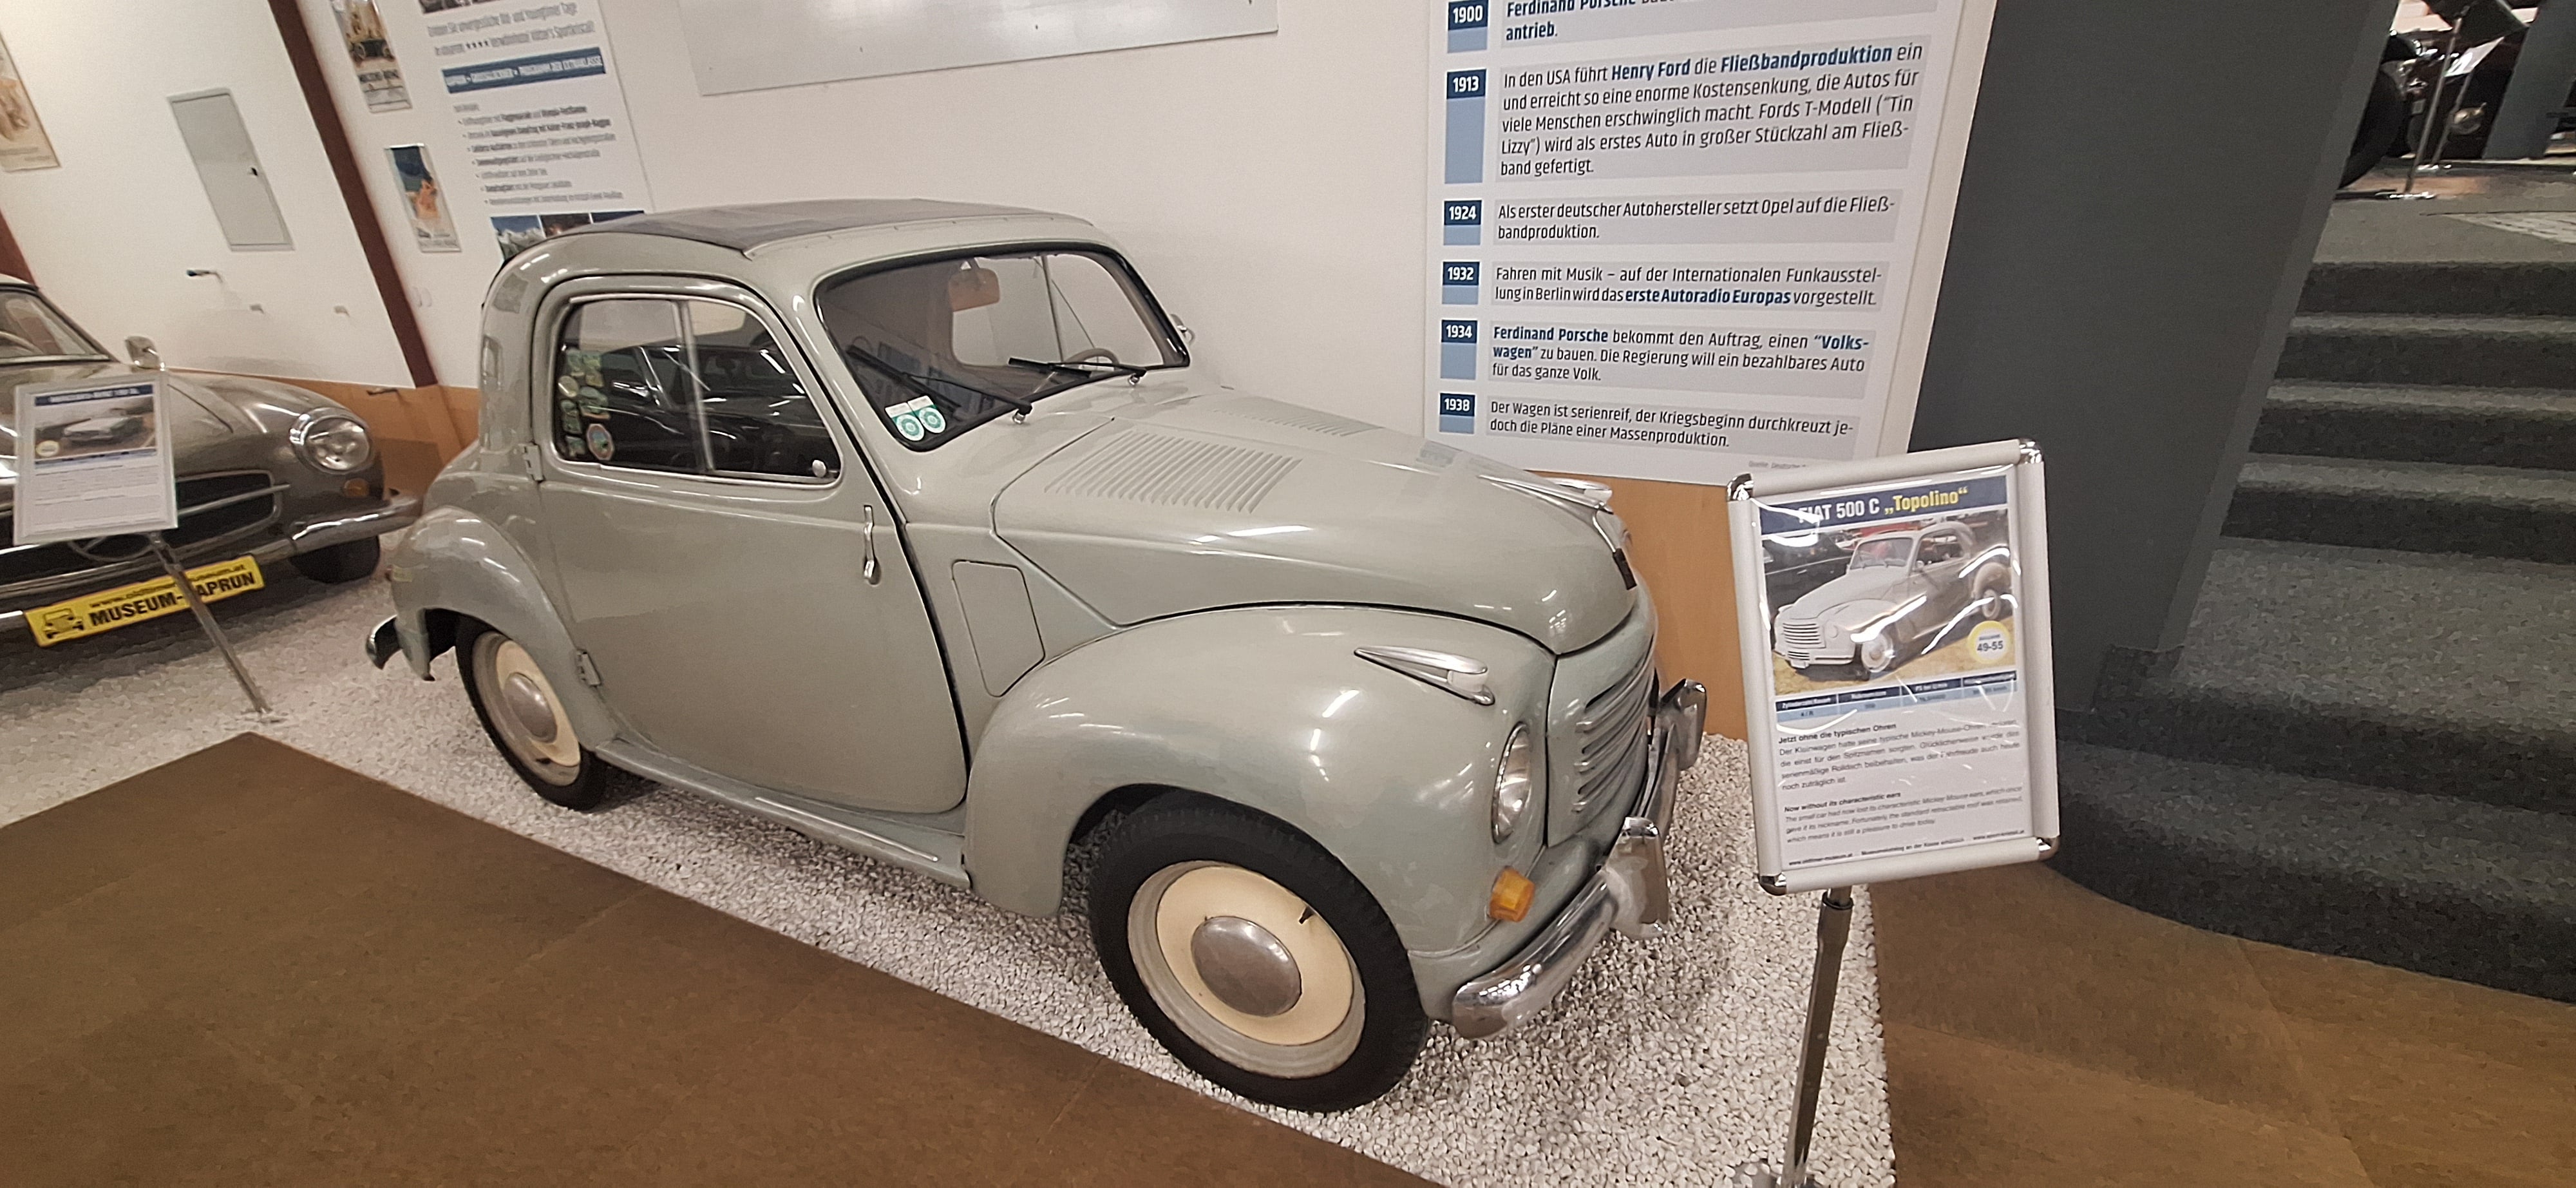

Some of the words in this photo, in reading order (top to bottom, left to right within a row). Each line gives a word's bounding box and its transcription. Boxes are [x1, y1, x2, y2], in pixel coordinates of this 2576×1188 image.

[1453, 5, 1482, 24] 1900
[1507, 0, 1575, 17] Ferdinand
[1506, 22, 1558, 41] antrieb.
[1504, 73, 1515, 88] In
[1519, 72, 1542, 87] den
[1547, 69, 1571, 85] USA
[1575, 66, 1608, 83] führt
[1611, 64, 1654, 81] Henry
[1658, 58, 1691, 77] Ford
[1694, 57, 1717, 75] die
[1721, 45, 1892, 73] Fließbandproduktion
[1897, 42, 1922, 61] ein
[1453, 75, 1479, 93] 1913
[1504, 94, 1527, 111] und
[1530, 91, 1581, 109] erreicht
[1584, 92, 1599, 106] so
[1603, 88, 1631, 104] eine
[1636, 86, 1689, 102] enorme
[1693, 77, 1812, 99] Kostensenkung,
[1817, 73, 1841, 91] die
[1843, 73, 1890, 90] Autos
[1895, 69, 1919, 86] für
[1502, 117, 1531, 133] viele
[1536, 113, 1601, 131] Menschen
[1605, 106, 1700, 127] erschwinglich
[1705, 104, 1754, 122] macht.
[1759, 101, 1800, 119] Fords
[1805, 97, 1871, 117] T-Modell
[1545, 136, 1573, 152] wird
[1577, 135, 1595, 151] als
[1600, 135, 1641, 149] erstes
[1645, 133, 1678, 148] Auto
[1682, 130, 1695, 146] in
[1699, 128, 1751, 148] großer
[1754, 124, 1828, 143] Stückzahl
[1832, 126, 1857, 139] am
[1862, 120, 1909, 139] Fließ-
[1501, 160, 1531, 176] band
[1534, 158, 1594, 177] gefertigt.
[1449, 206, 1477, 221] 1924
[1498, 204, 1516, 219] Als
[1519, 205, 1556, 218] erster
[1557, 202, 1622, 218] deutscher
[1623, 200, 1722, 216] Autohersteller
[1723, 200, 1759, 215] setzt
[1761, 198, 1794, 216] Opel
[1796, 196, 1823, 213] auf
[1824, 196, 1847, 213] die
[1850, 196, 1895, 212] Fließ-
[1498, 224, 1600, 241] bandproduktion.
[1447, 267, 1474, 281] 1932
[1496, 267, 1537, 280] Fahren
[1541, 267, 1562, 281] mit
[1566, 267, 1603, 281] Musik
[1620, 267, 1642, 281] auf
[1646, 267, 1669, 282] der
[1672, 267, 1781, 282] Internationalen
[1786, 267, 1882, 283] Funkausstel-
[1495, 285, 1521, 303] lung
[1522, 285, 1534, 302] in
[1536, 286, 1571, 302] Berlin
[1573, 287, 1600, 302] wird
[1602, 287, 1624, 302] das
[1625, 288, 1660, 303] erste
[1661, 287, 1730, 303] Autoradio
[1732, 289, 1791, 307] Europas
[1794, 289, 1877, 308] vorgestellt.
[1446, 325, 1473, 338] 1934
[1493, 326, 1554, 340] Ferdinand
[1558, 329, 1608, 342] Porsche
[1613, 329, 1674, 345] bekommt
[1679, 331, 1703, 345] den
[1709, 332, 1763, 350] Auftrag,
[1768, 333, 1808, 349] einen
[1540, 349, 1553, 359] zu
[1557, 347, 1597, 361] bauen.
[1600, 349, 1620, 362] Die
[1622, 350, 1689, 367] Regierung
[1692, 352, 1715, 366] will
[1718, 352, 1739, 367] ein
[1743, 354, 1828, 370] bezahlbares
[1830, 358, 1864, 372] Auto
[1493, 363, 1509, 376] für
[1512, 364, 1531, 378] das
[1534, 367, 1569, 380] ganze
[1573, 367, 1601, 381] Volk.
[1444, 398, 1470, 412] 1938
[1491, 401, 1510, 414] Der
[1513, 403, 1550, 417] Wagen
[1554, 404, 1568, 417] ist
[1571, 406, 1632, 423] serienreif,
[1636, 409, 1656, 423] der
[1660, 411, 1745, 429] Kriegsbeginn
[1748, 416, 1832, 434] durchkreuzt
[1833, 420, 1853, 437] je-
[1490, 418, 1517, 432] doch
[1520, 421, 1538, 434] die
[1540, 422, 1573, 436] Pläne
[1577, 424, 1607, 438] einer
[1610, 427, 1729, 447] Massenproduktion.
[1798, 504, 1832, 523] FIAT
[1836, 500, 1865, 519] 500
[1869, 498, 1880, 514] C
[89, 572, 255, 627] MUSEUM-APRUN
[1977, 640, 2003, 651] 49-55
[1779, 736, 1797, 744] Jetzt
[1834, 726, 1871, 738] typischen
[1801, 801, 1828, 810] without
